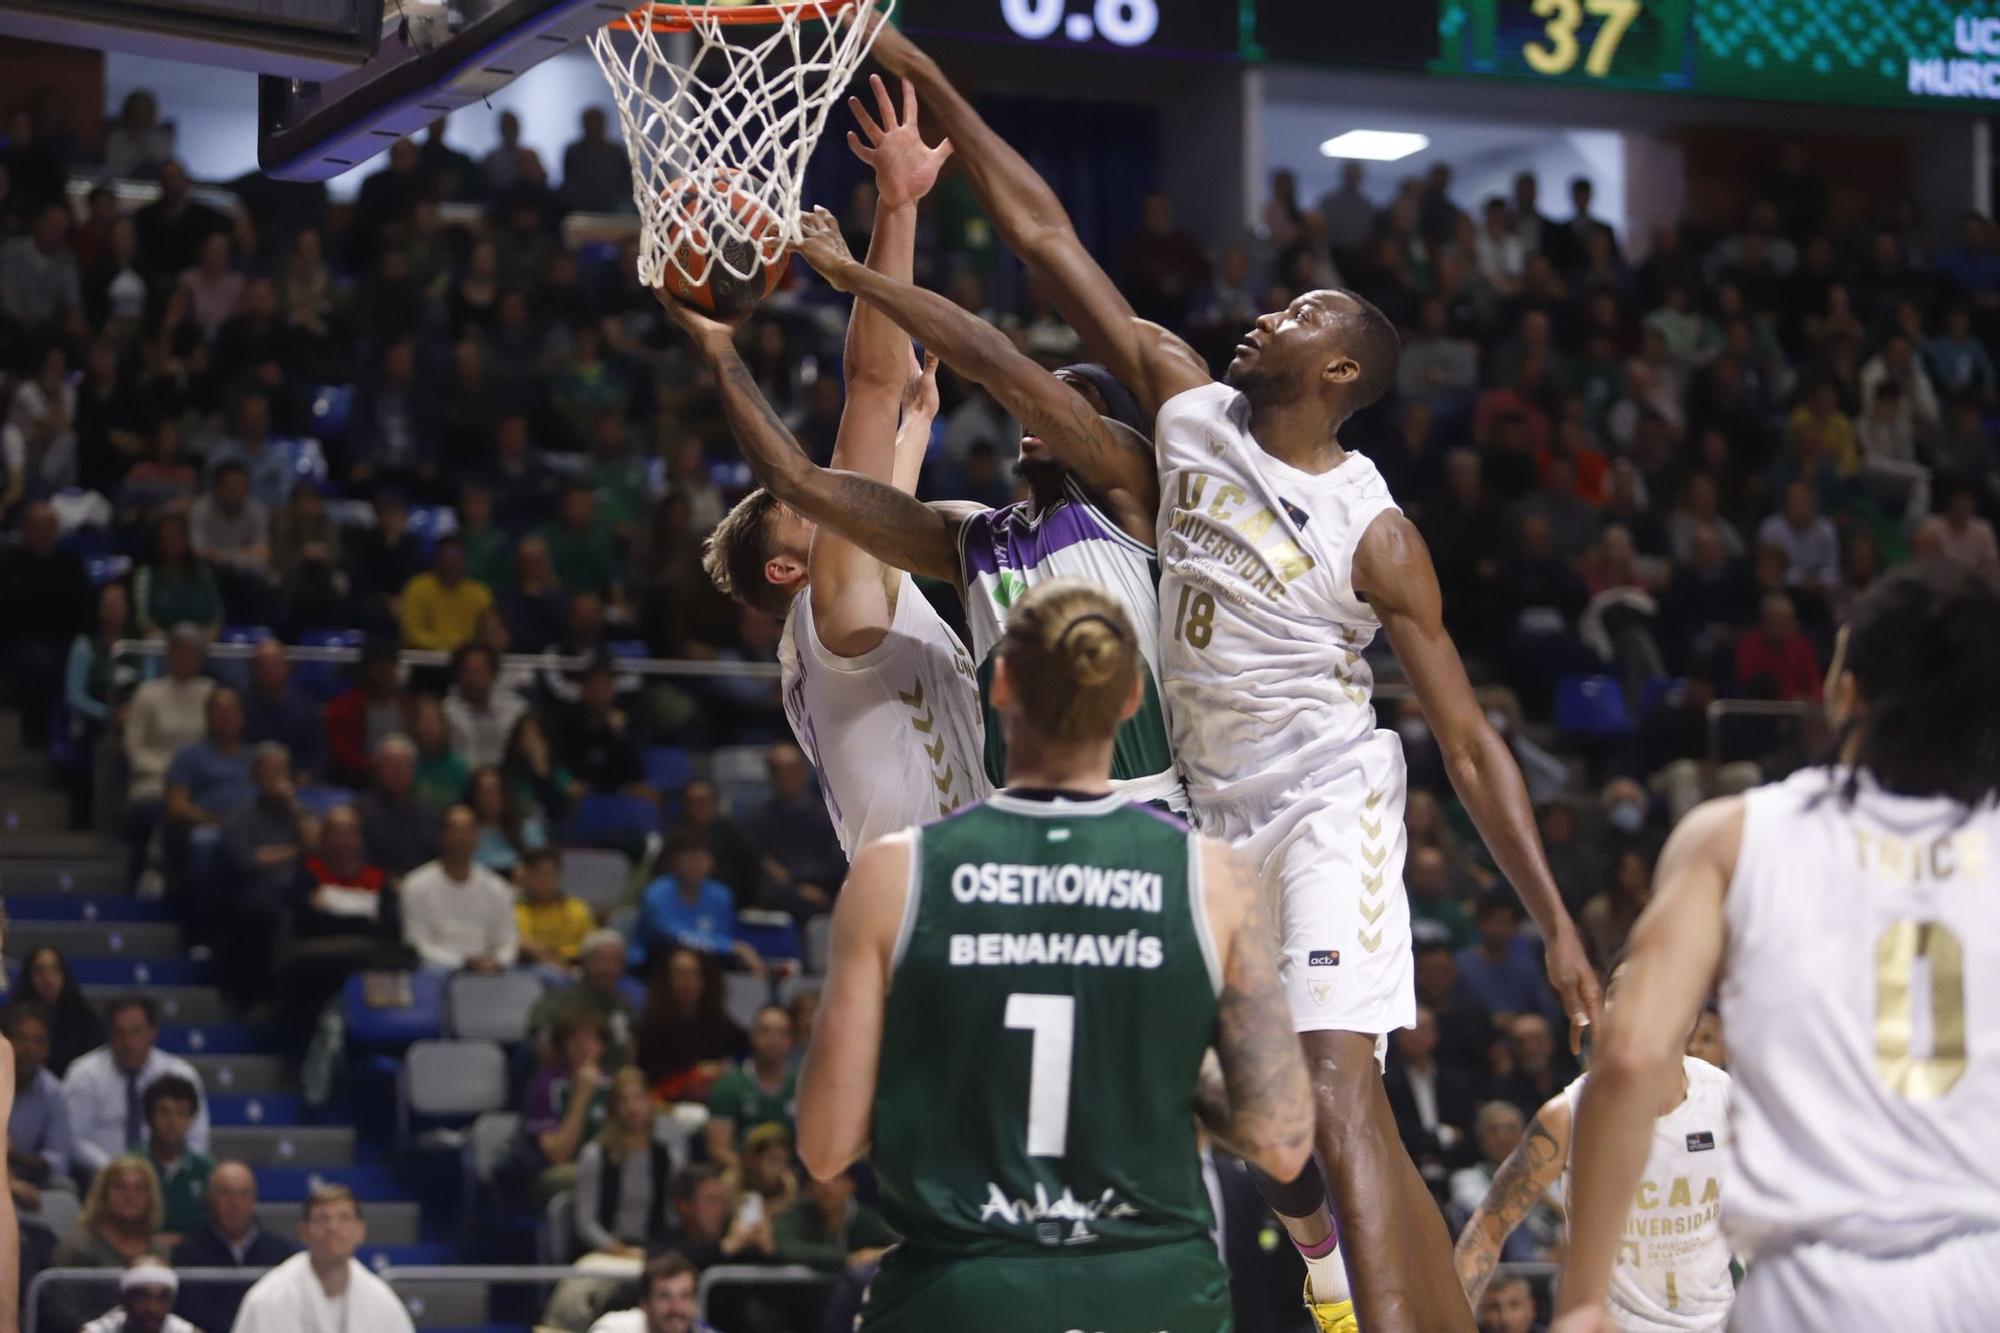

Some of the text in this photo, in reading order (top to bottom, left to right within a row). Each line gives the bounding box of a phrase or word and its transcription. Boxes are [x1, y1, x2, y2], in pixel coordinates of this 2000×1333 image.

[1522, 0, 1642, 78] 37
[1174, 583, 1216, 650] 18
[951, 864, 1163, 913] OSETKOWSKI
[949, 929, 1164, 969] BENAHAVÍS
[1310, 955, 1334, 966] acb
[1874, 918, 1968, 1100] 0
[1004, 993, 1076, 1158] 1
